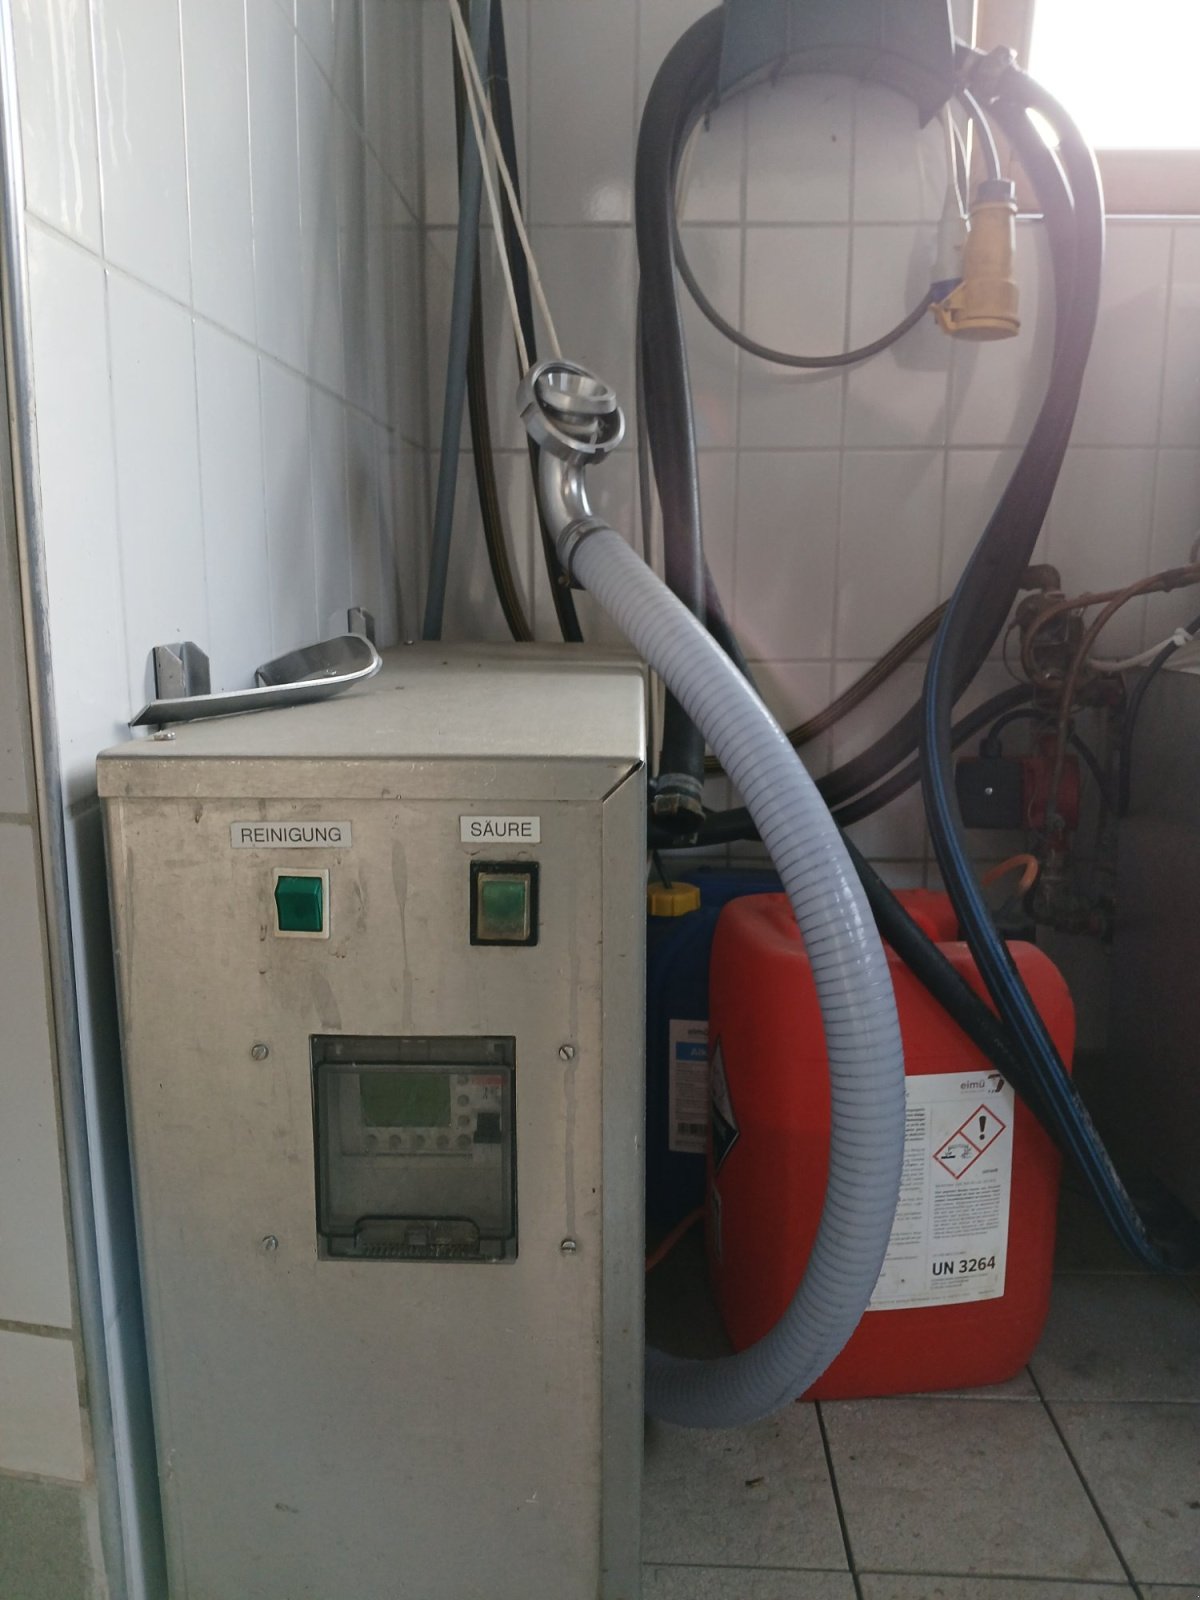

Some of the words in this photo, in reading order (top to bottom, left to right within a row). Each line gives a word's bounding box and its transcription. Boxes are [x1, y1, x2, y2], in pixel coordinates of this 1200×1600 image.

[240, 826, 341, 843] REINIGUNG
[470, 819, 533, 838] SÄURE
[932, 1260, 954, 1276] UN
[958, 1255, 996, 1273] 3264
